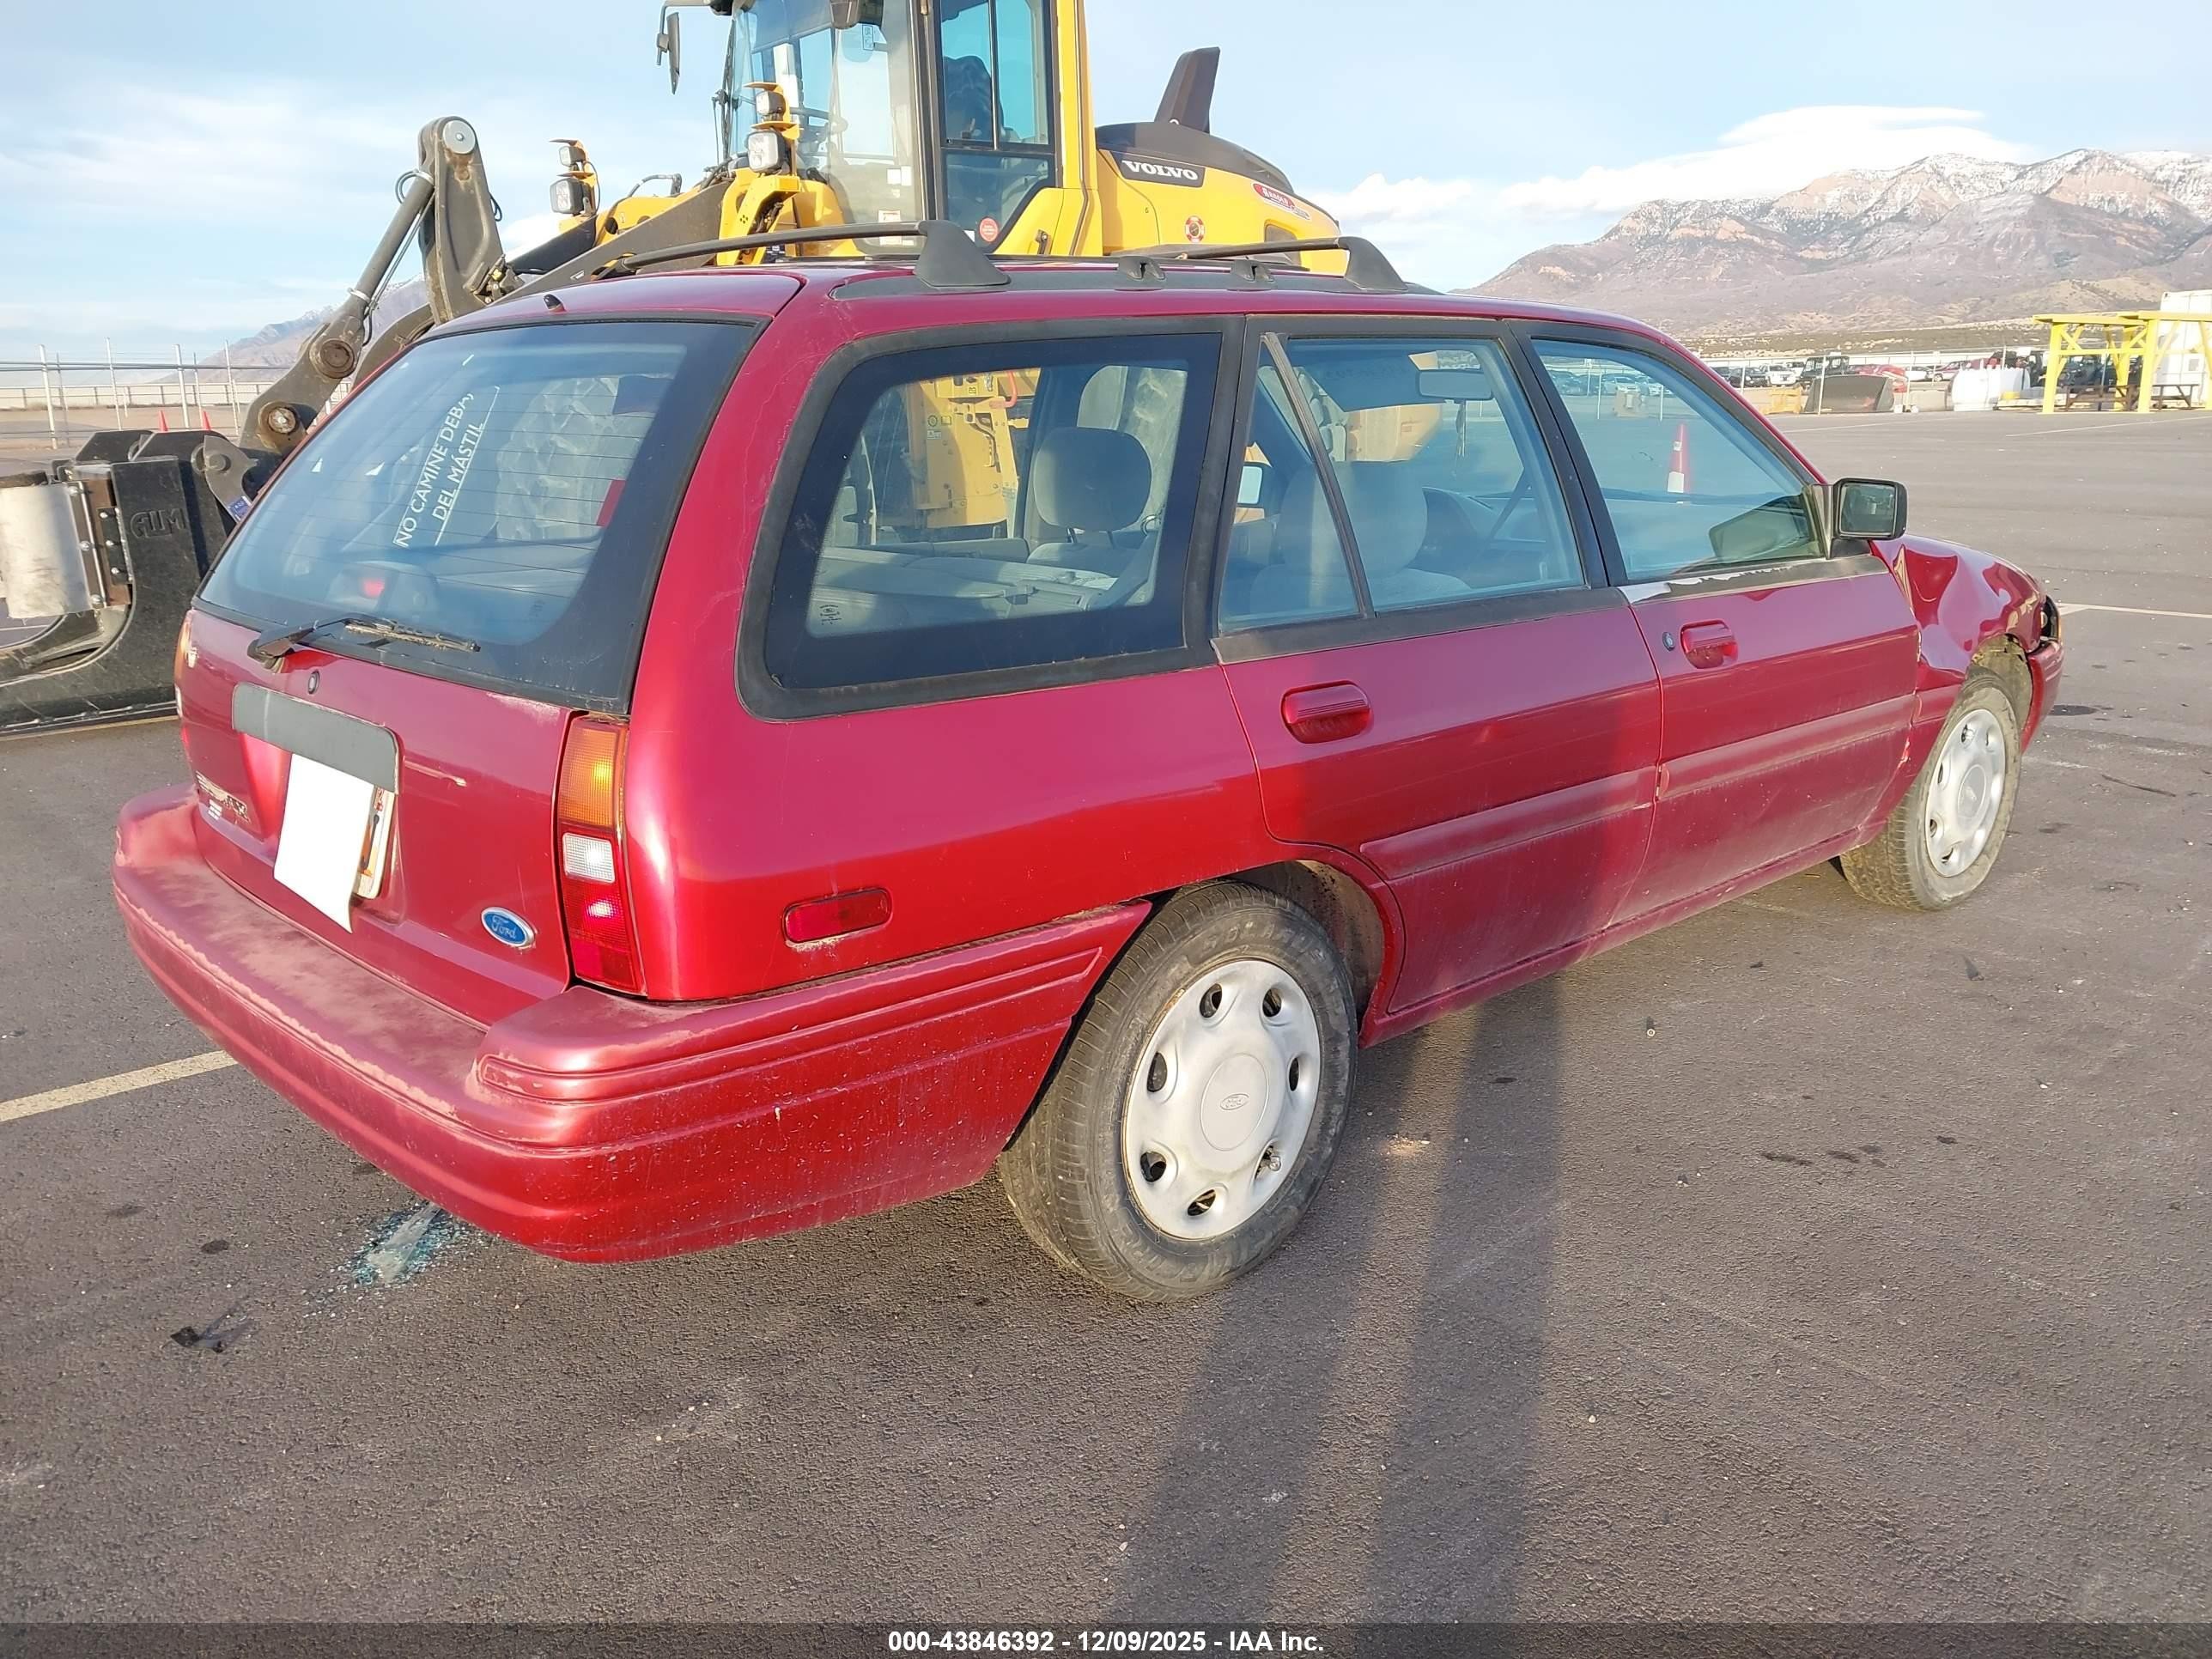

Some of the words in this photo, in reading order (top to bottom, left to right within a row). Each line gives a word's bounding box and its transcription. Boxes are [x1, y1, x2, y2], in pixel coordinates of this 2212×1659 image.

[1121, 160, 1199, 180] VOLVO
[395, 517, 416, 547] NO
[410, 443, 448, 513] CAMINE
[432, 489, 456, 520] DEL
[447, 423, 483, 483] MÁSTIL
